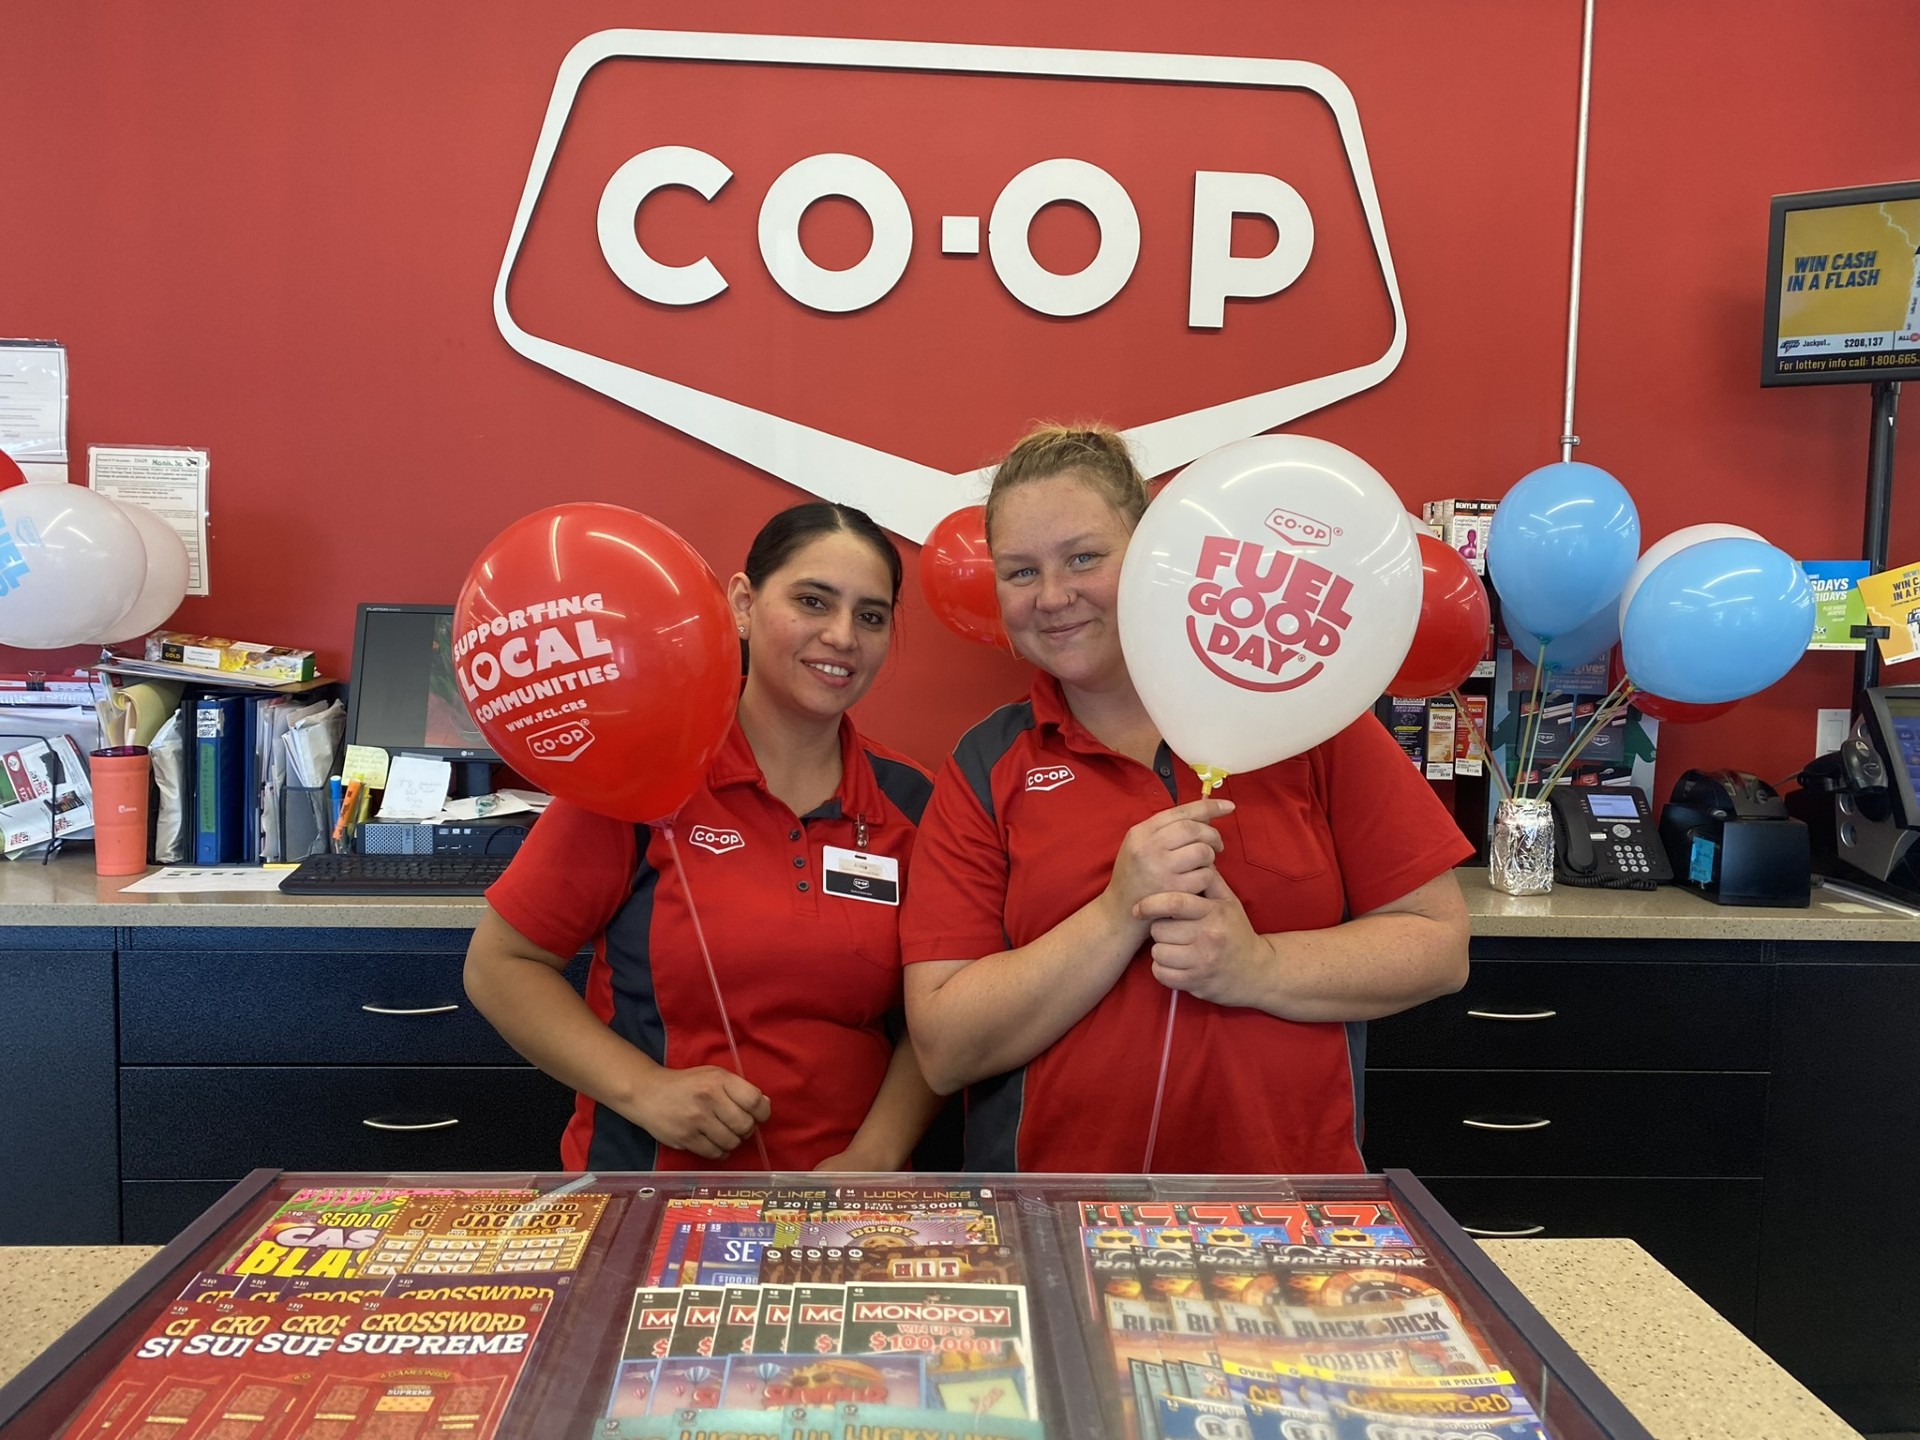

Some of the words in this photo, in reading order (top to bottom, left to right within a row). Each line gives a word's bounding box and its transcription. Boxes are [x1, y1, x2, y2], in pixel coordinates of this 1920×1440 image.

[597, 145, 1315, 329] CO-OP
[1794, 255, 1829, 274] WIN
[1831, 250, 1879, 271] CASH
[1786, 274, 1805, 293] IN
[1808, 273, 1820, 291] A
[1824, 269, 1881, 290] FLASH
[1844, 336, 1884, 348] $208,137
[1779, 360, 1794, 371] For
[1795, 358, 1826, 371] lottery
[1828, 357, 1847, 368] info
[1849, 355, 1868, 367] call:
[1871, 353, 1920, 366] 1-800-665-
[1272, 514, 1327, 540] CO-OP
[1195, 535, 1355, 631] FUEL
[1811, 578, 1849, 592] SDAYS
[1892, 580, 1911, 592] WIN
[1815, 591, 1848, 602] RIDAYS
[1893, 591, 1904, 601] IN
[1905, 589, 1913, 599] A
[453, 593, 604, 663] SUPPORTING
[1187, 582, 1341, 657] GOOD
[164, 651, 181, 660] GOLD
[1206, 622, 1301, 676] DAY
[458, 619, 613, 702] LOCAL
[475, 663, 621, 724] COMMUNITIES
[532, 726, 586, 754] CO-OP
[1028, 770, 1069, 787] CO-OP
[695, 831, 739, 845] CO-OP
[717, 1190, 774, 1198] LUCKY
[777, 1190, 827, 1199] LINES
[863, 1190, 919, 1199] LUCKY
[923, 1190, 971, 1199] LINES
[317, 1212, 394, 1228] $500,0
[452, 1212, 584, 1229] JACKPOT
[710, 1223, 722, 1231] $5
[275, 1226, 380, 1250] CAS
[848, 1224, 919, 1239] DOGGY
[235, 1240, 369, 1279] BLA
[1139, 1258, 1194, 1268] RAC
[1273, 1255, 1338, 1265] RACE
[1359, 1258, 1431, 1267] BANK
[895, 1262, 958, 1278] HIT
[360, 1311, 526, 1333] CROSSWORD
[859, 1305, 1005, 1323] MONOPOLY
[897, 1323, 928, 1335] WIN
[930, 1324, 951, 1335] UP
[952, 1326, 975, 1337] TO
[1291, 1319, 1370, 1338] BLACK
[1382, 1311, 1450, 1335] JACK
[337, 1332, 529, 1356] SUPREME
[869, 1331, 1003, 1354] $100,000!
[1238, 1367, 1276, 1379] OVER
[1439, 1379, 1451, 1387] IN
[1455, 1377, 1498, 1386] PRIZES!
